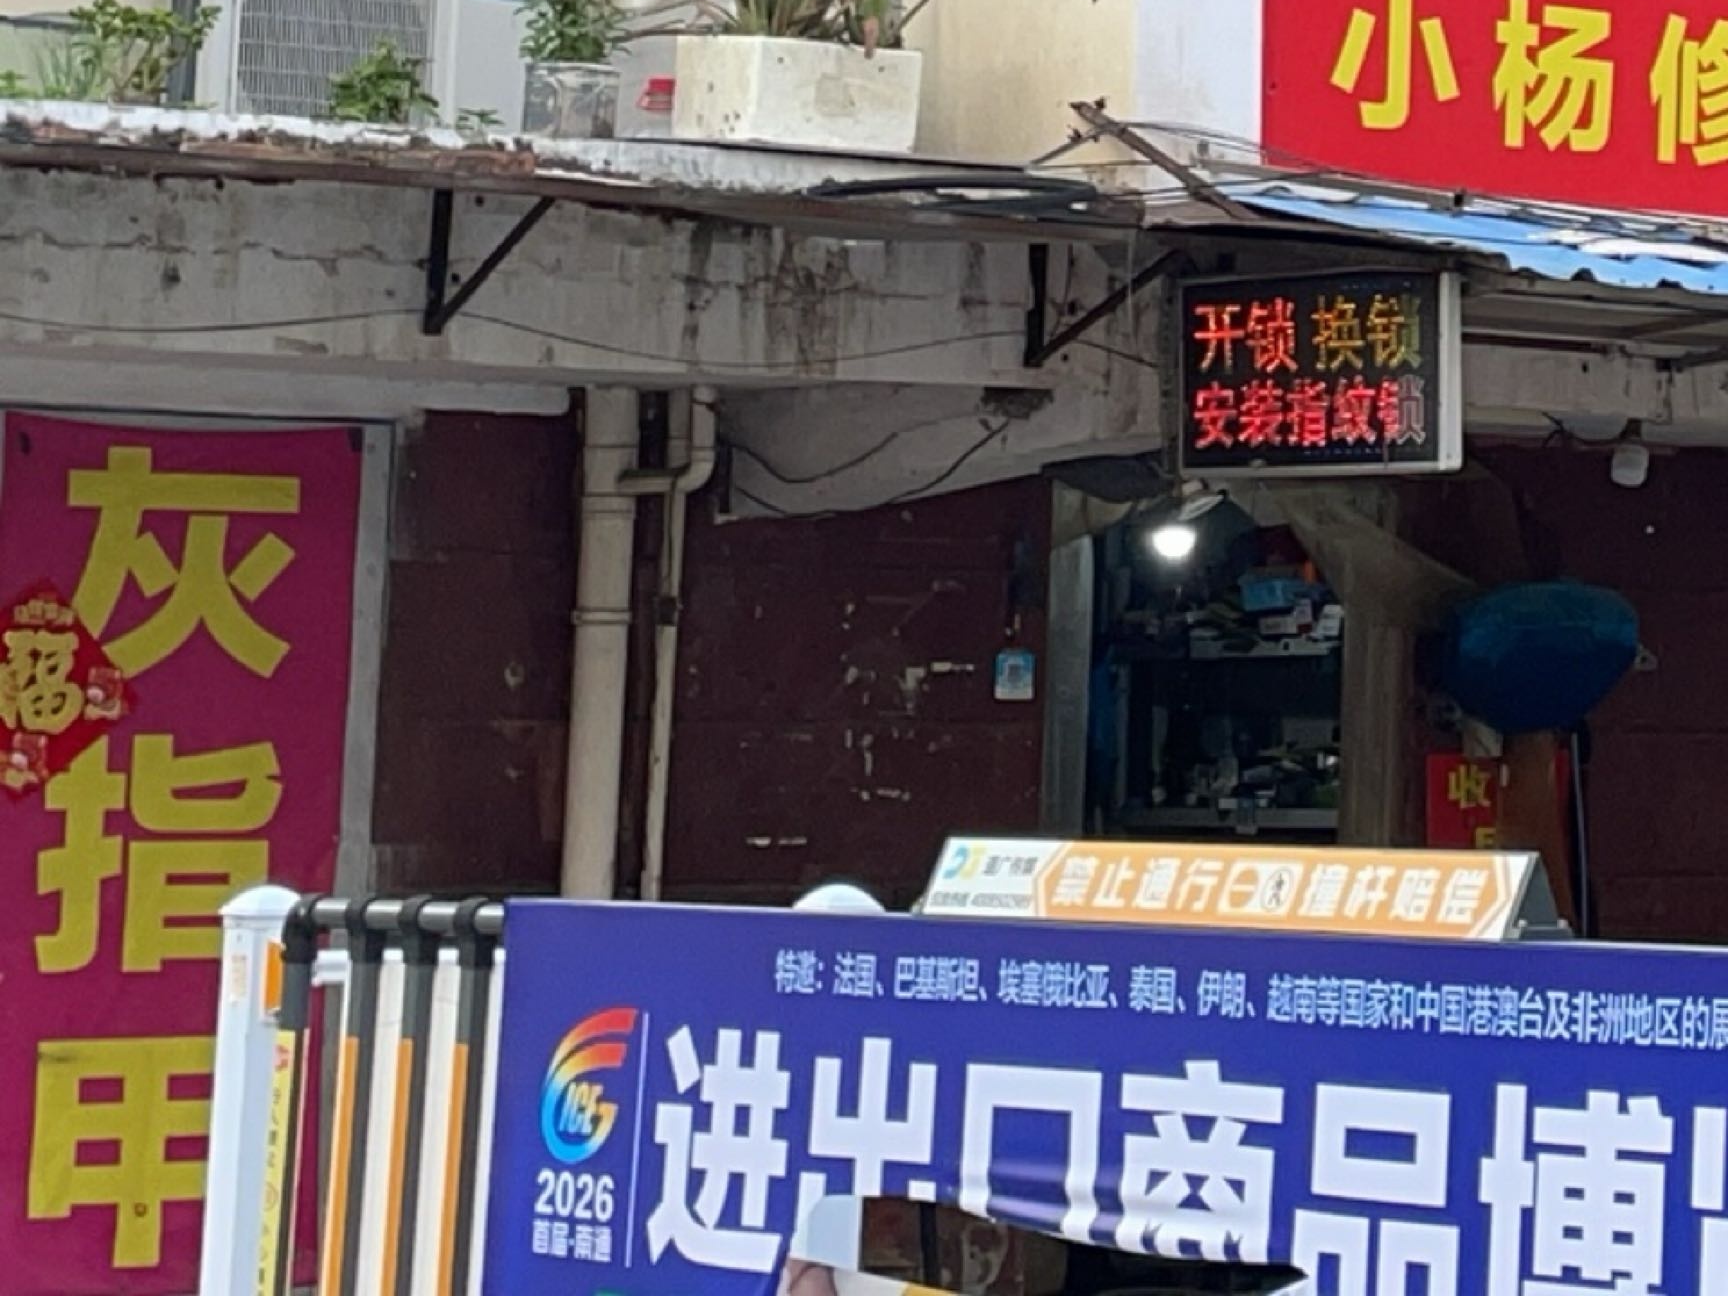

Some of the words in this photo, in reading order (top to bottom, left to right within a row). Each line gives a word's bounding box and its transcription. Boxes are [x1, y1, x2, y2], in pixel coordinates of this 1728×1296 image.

[1193, 296, 1297, 372] 开锁
[1311, 294, 1423, 371] 换锁
[1192, 374, 1426, 449] 安装指纹锁
[26, 444, 301, 1269] 灰指甲
[1050, 854, 1225, 913] 禁止通行
[1297, 861, 1489, 925] 撞杆赔偿
[534, 1168, 614, 1223] 2026
